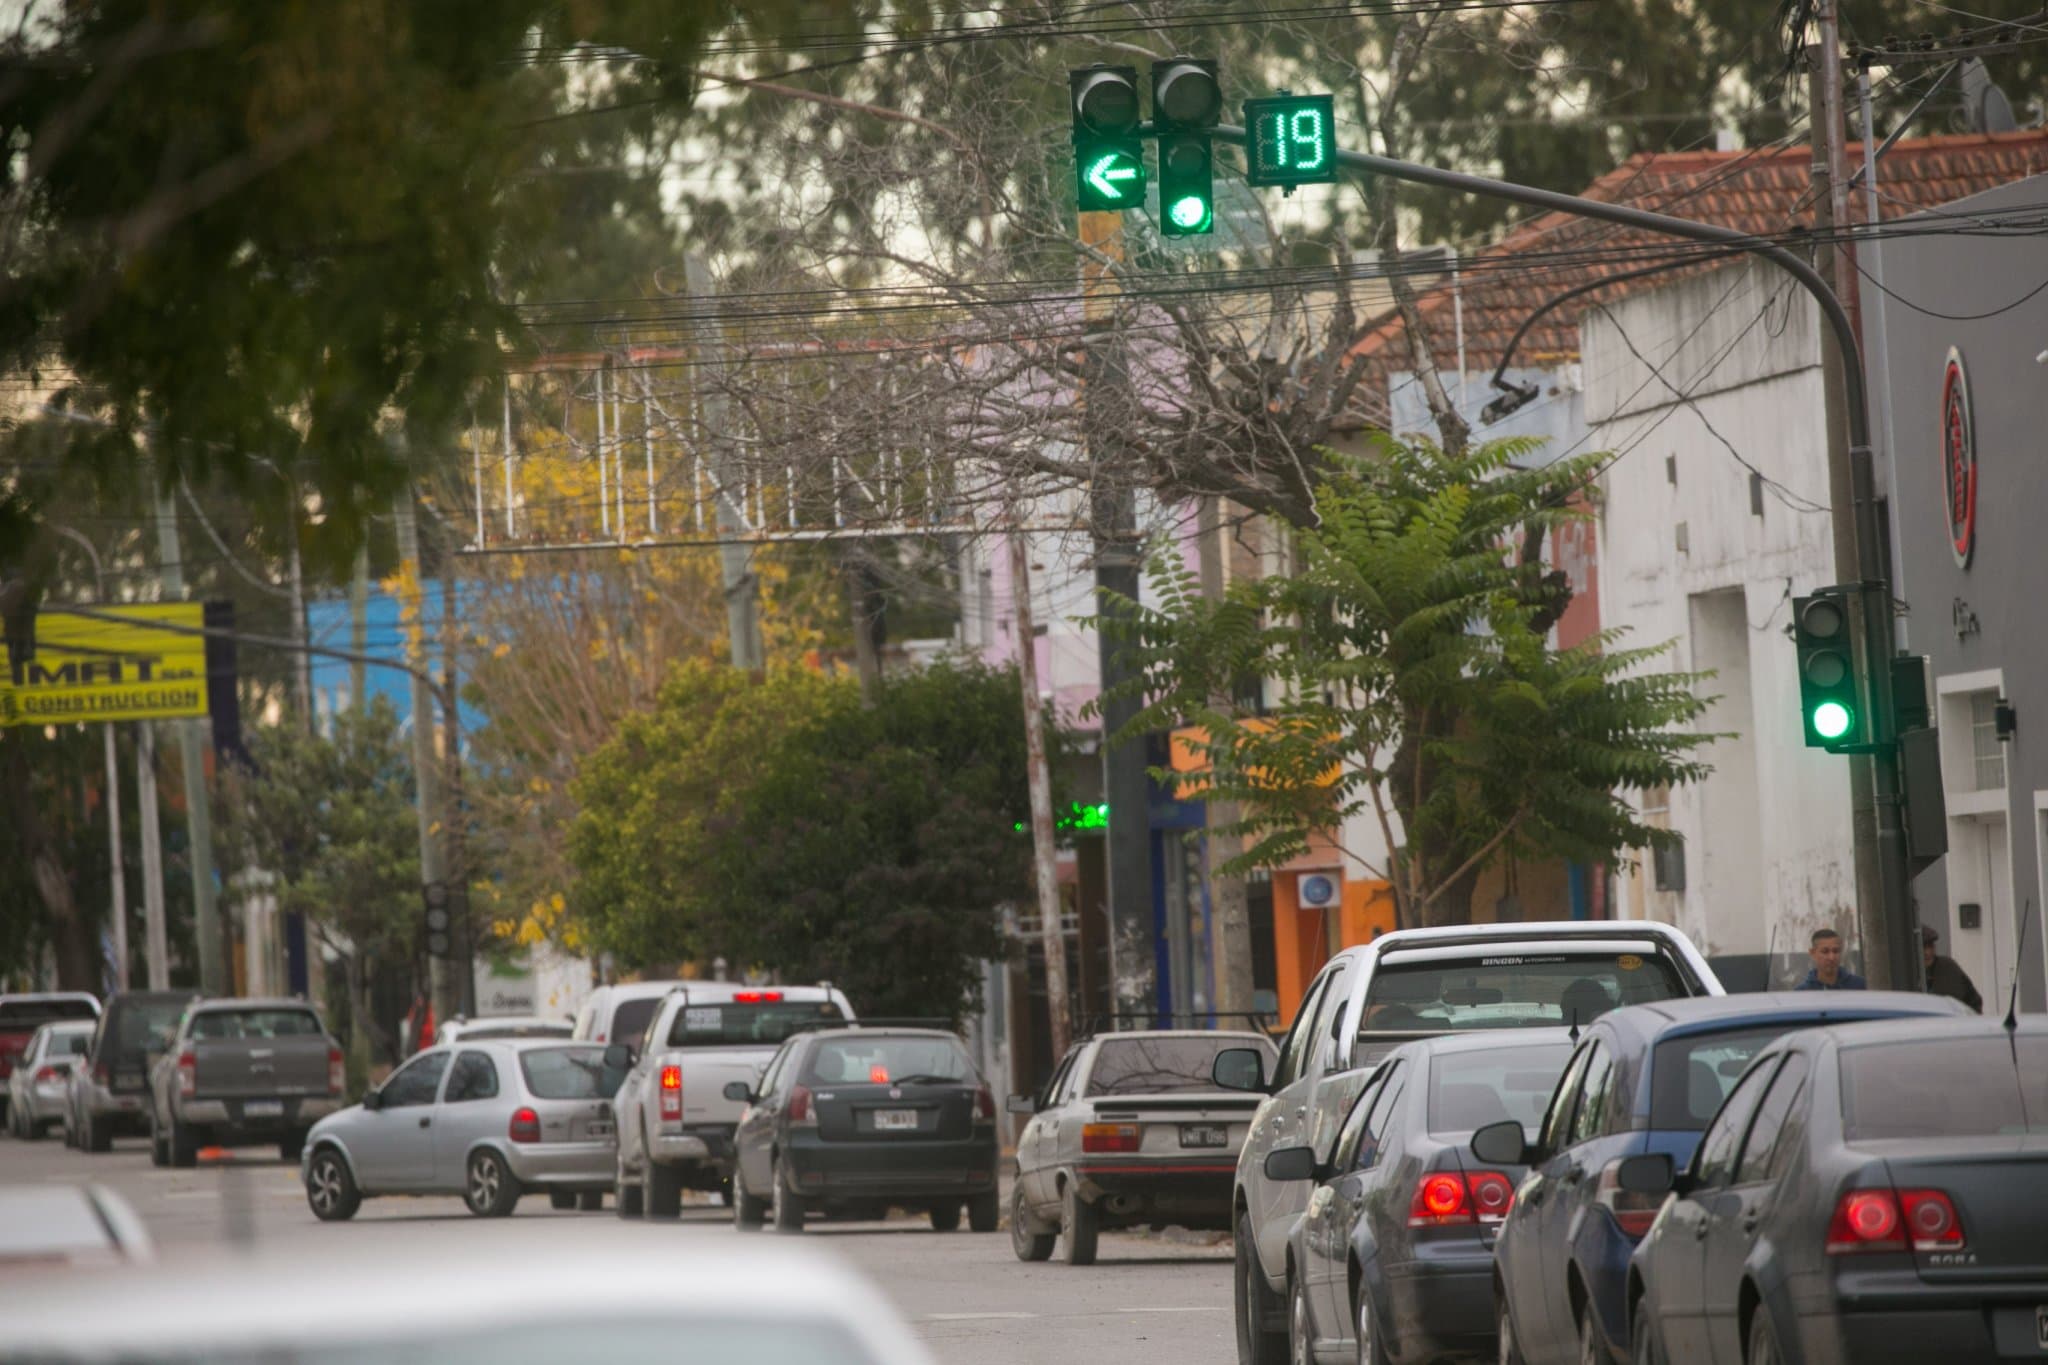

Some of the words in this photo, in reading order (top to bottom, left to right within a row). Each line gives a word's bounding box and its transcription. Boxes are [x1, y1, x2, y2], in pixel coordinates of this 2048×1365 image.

[1276, 109, 1323, 169] 19
[24, 690, 198, 715] CONSTRUCCION
[1481, 957, 1523, 966] RINCON
